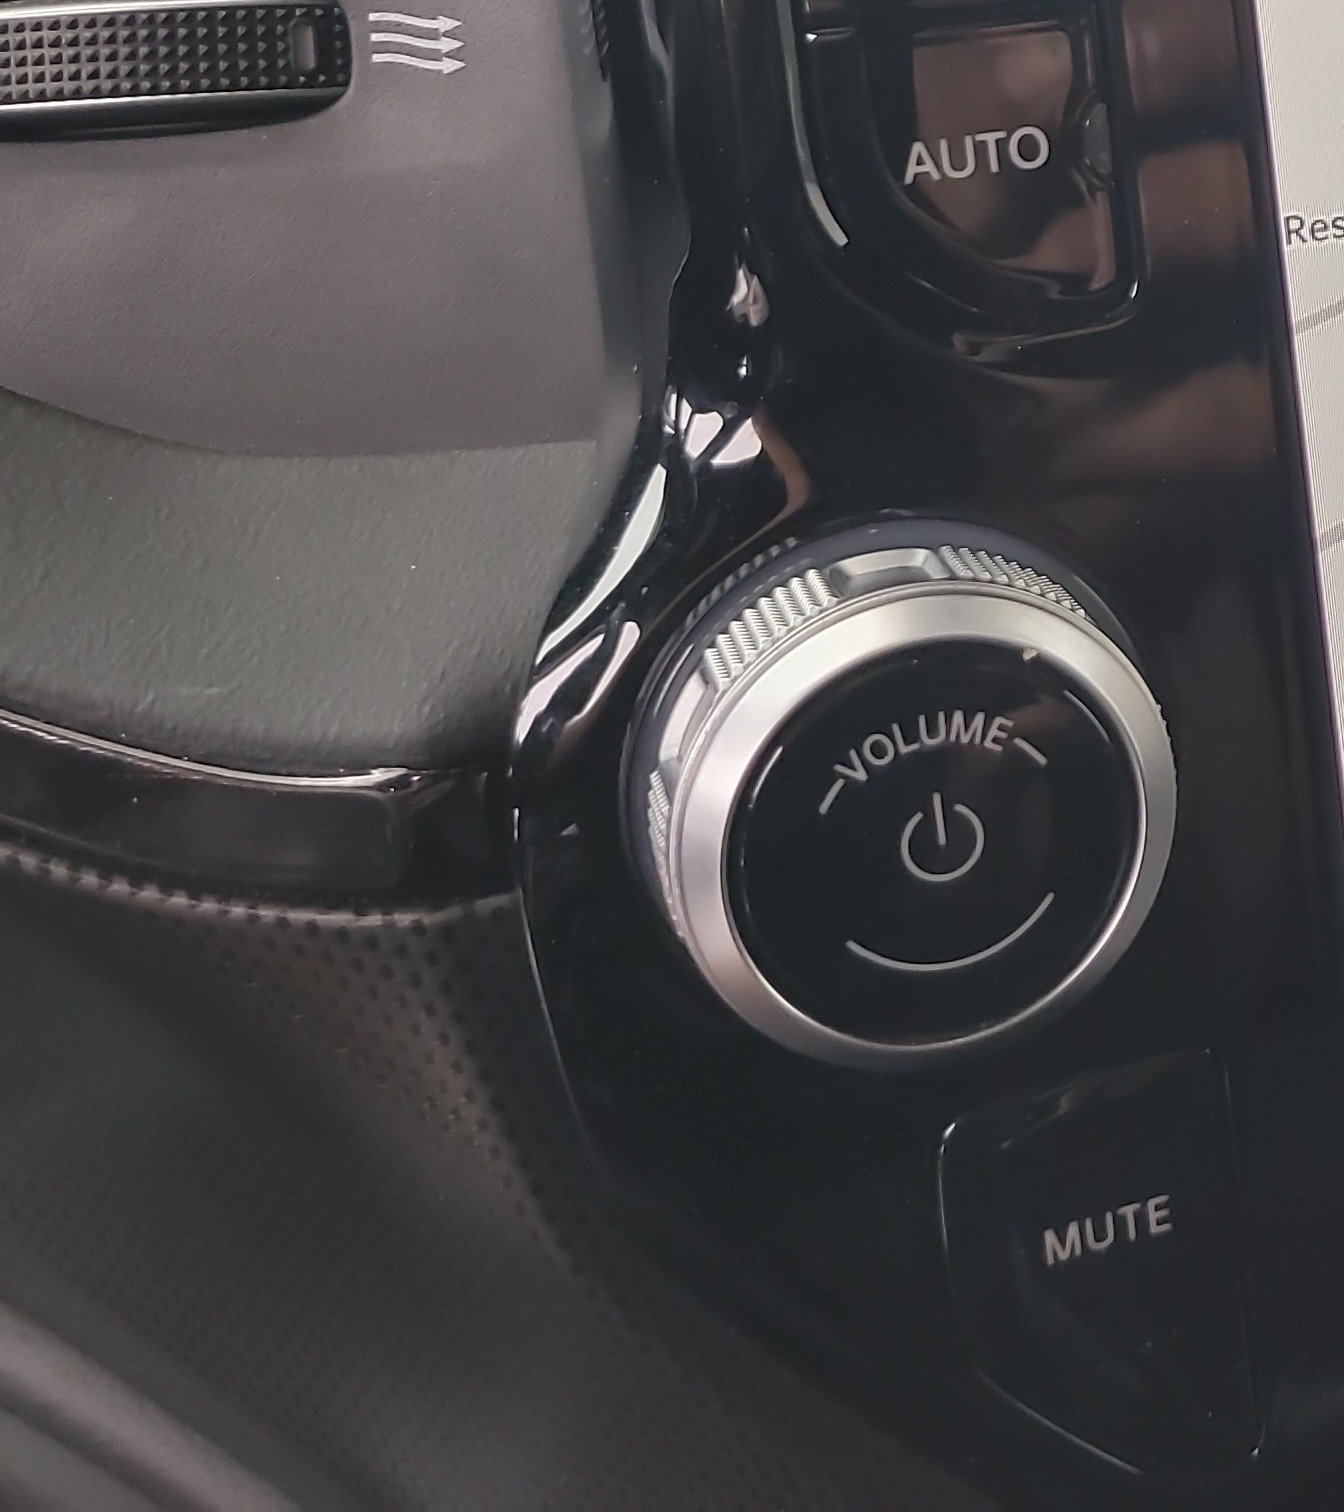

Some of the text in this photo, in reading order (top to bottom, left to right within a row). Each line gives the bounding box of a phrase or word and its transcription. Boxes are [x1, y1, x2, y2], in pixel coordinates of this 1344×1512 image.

[902, 125, 1050, 186] AUTO
[834, 709, 1014, 787] VOLUME
[1043, 1194, 1174, 1267] MUTE
